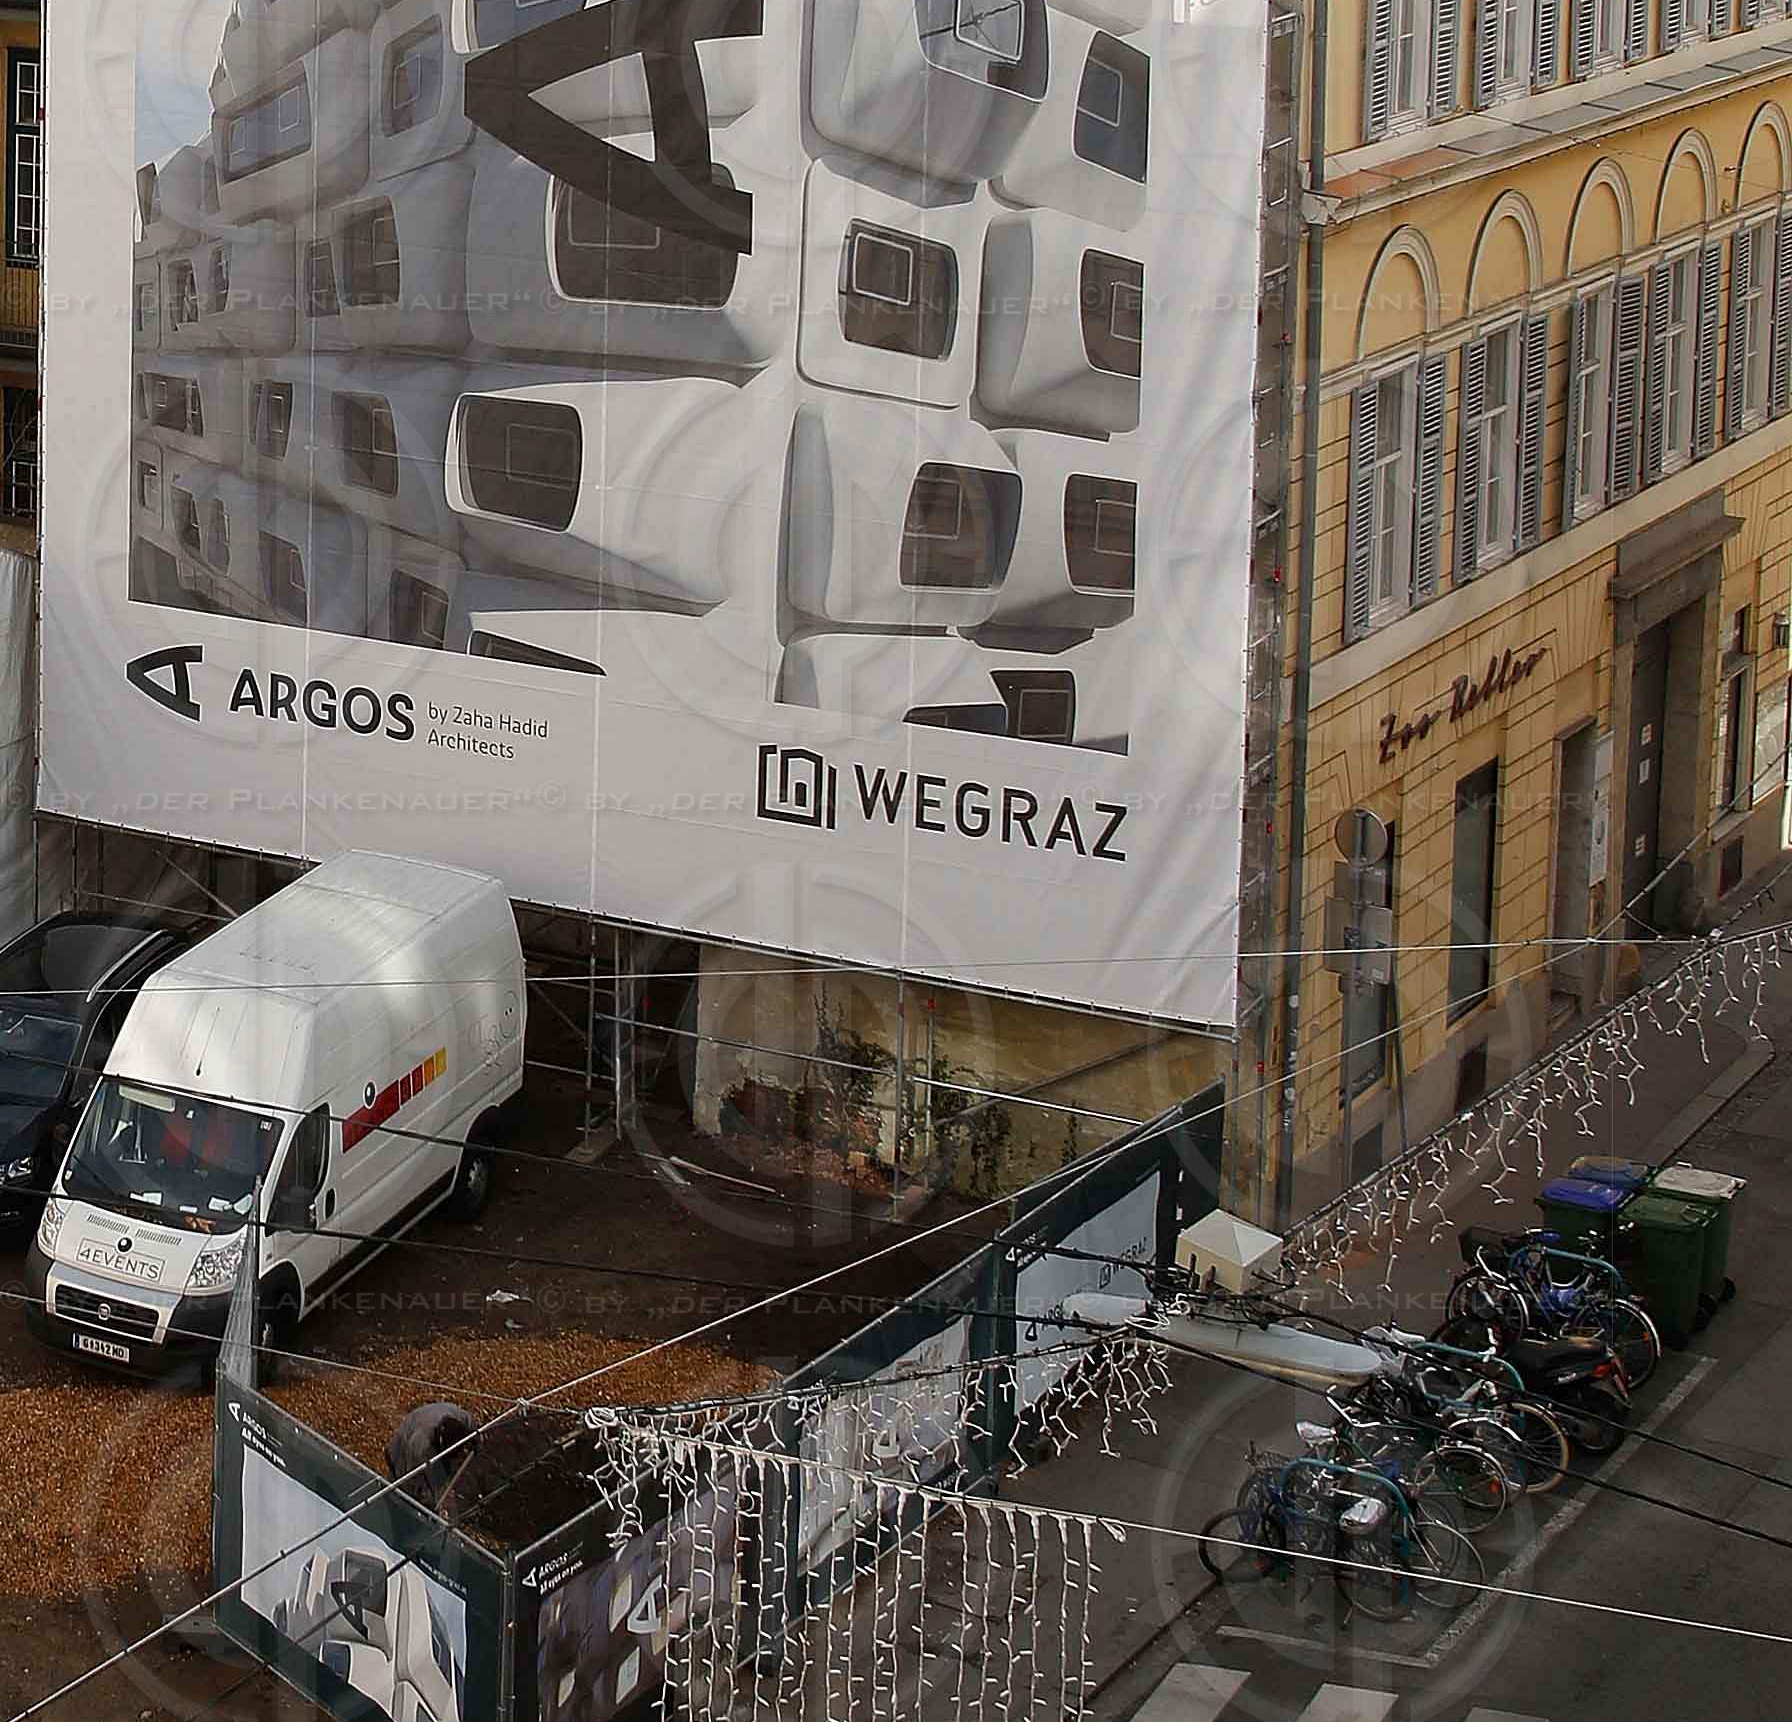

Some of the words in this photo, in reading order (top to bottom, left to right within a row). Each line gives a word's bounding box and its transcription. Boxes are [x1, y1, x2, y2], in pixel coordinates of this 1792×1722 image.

[229, 668, 415, 741] ARGOS
[428, 701, 448, 726] by
[452, 705, 493, 729] Zaha
[499, 713, 548, 738] Hadid
[427, 728, 515, 759] Architects
[854, 764, 1129, 862] WEGRAZ
[79, 1247, 160, 1279] 4EVENTS
